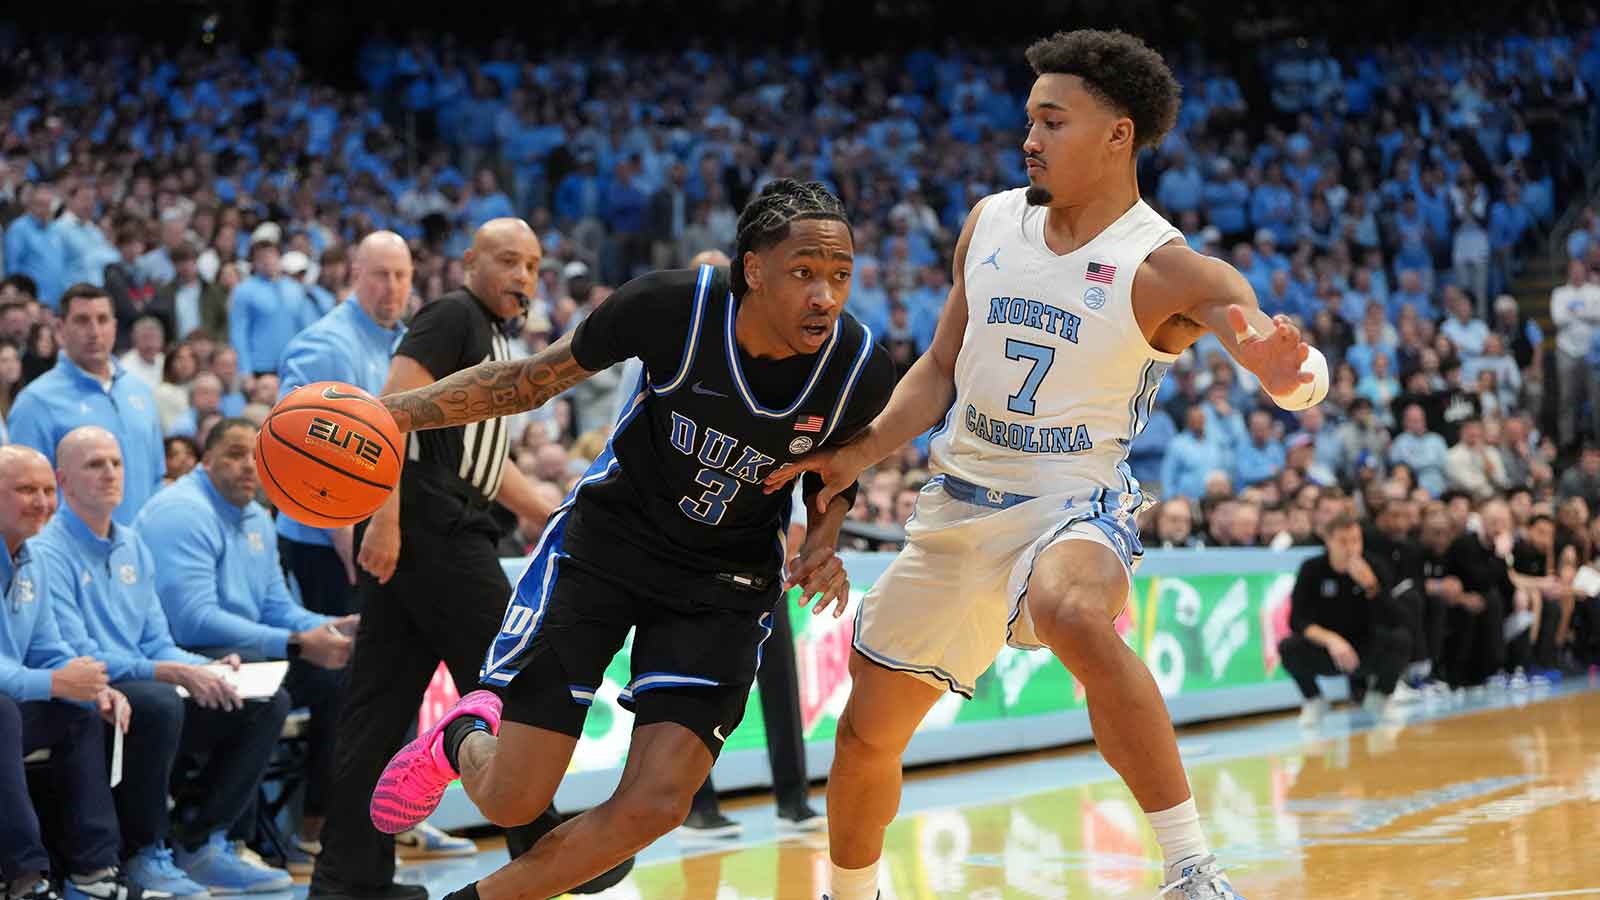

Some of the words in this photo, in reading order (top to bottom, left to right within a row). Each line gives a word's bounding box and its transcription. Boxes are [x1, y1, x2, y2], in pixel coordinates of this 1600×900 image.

[987, 296, 1082, 344] NORTH
[1005, 338, 1056, 417] 7
[307, 416, 383, 465] ELITE
[670, 410, 793, 485] DUK
[965, 404, 1092, 453] CAROLINA
[678, 468, 741, 526] 3
